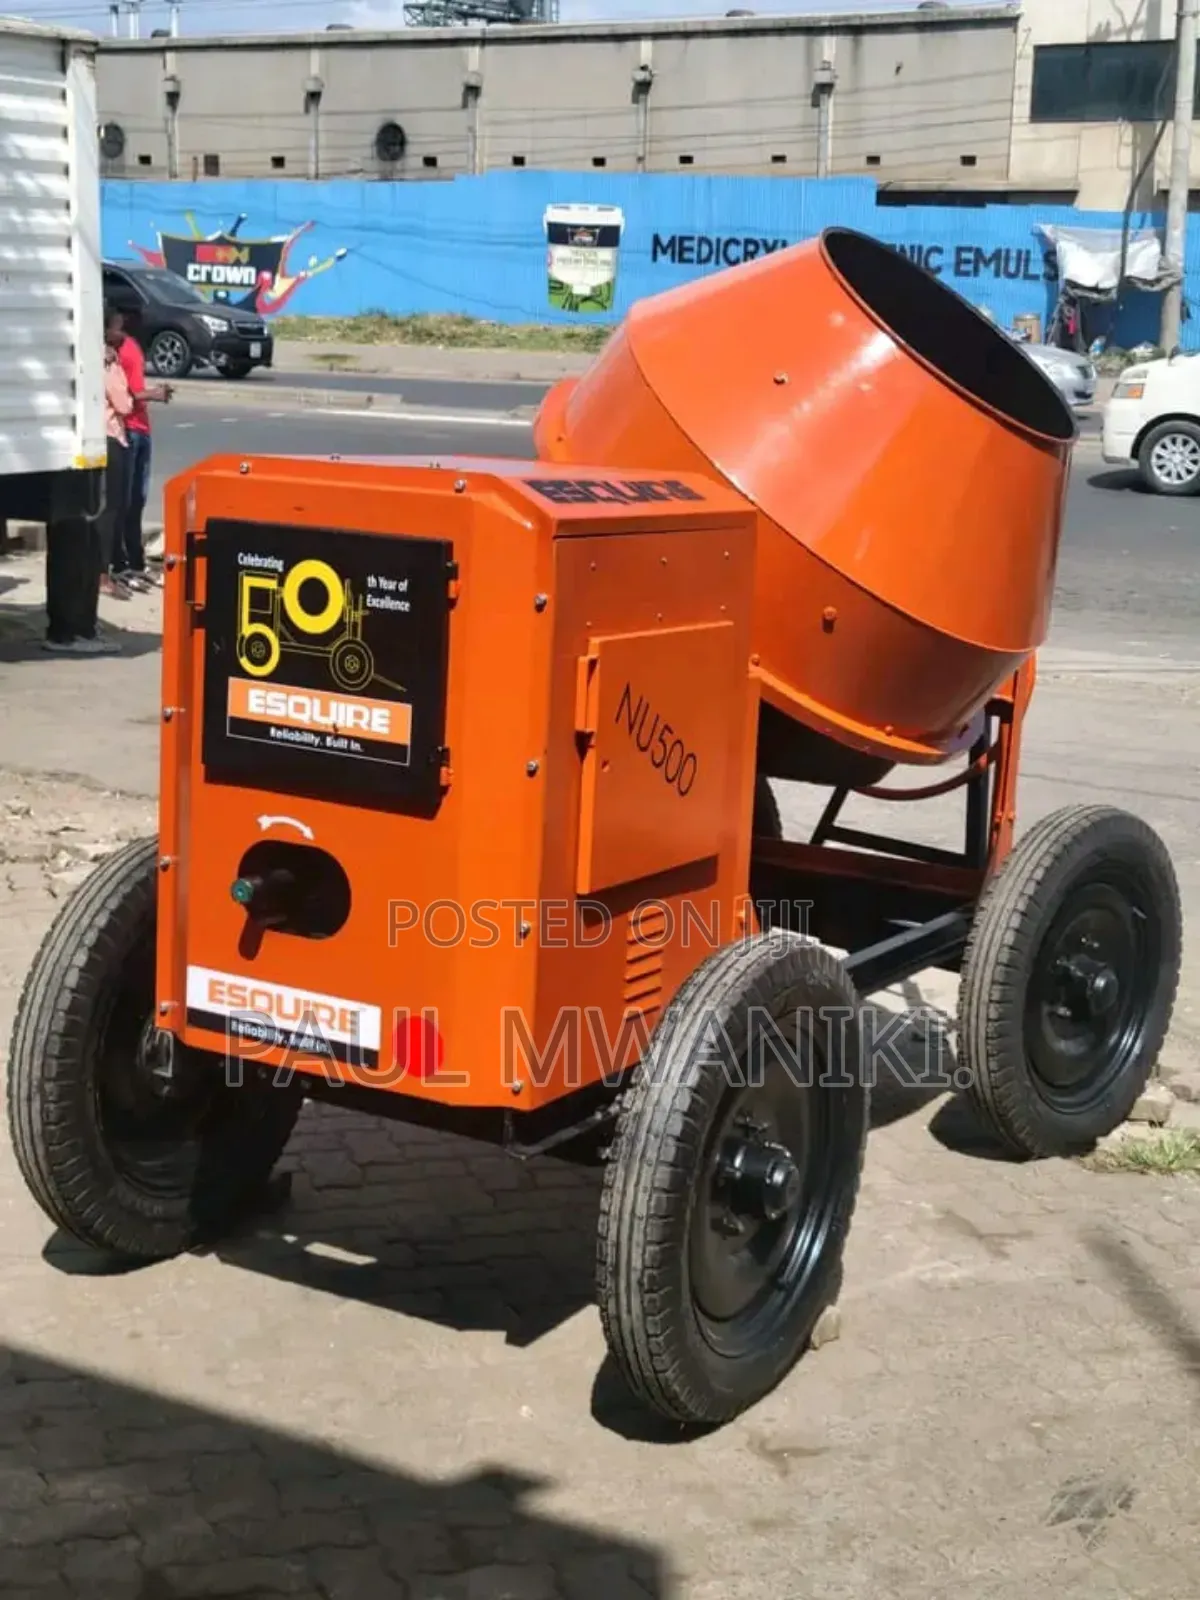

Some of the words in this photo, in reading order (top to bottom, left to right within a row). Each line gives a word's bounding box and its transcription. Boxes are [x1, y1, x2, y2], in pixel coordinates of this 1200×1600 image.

[522, 480, 707, 505] ESQUIRE
[237, 552, 284, 572] Celebrating
[366, 574, 378, 588] th
[378, 576, 397, 591] Year
[398, 578, 408, 591] of
[366, 594, 411, 612] Excellence
[248, 688, 391, 735] ESQUIRE
[615, 681, 698, 797] NU500
[207, 978, 358, 1036] ESQUIRE
